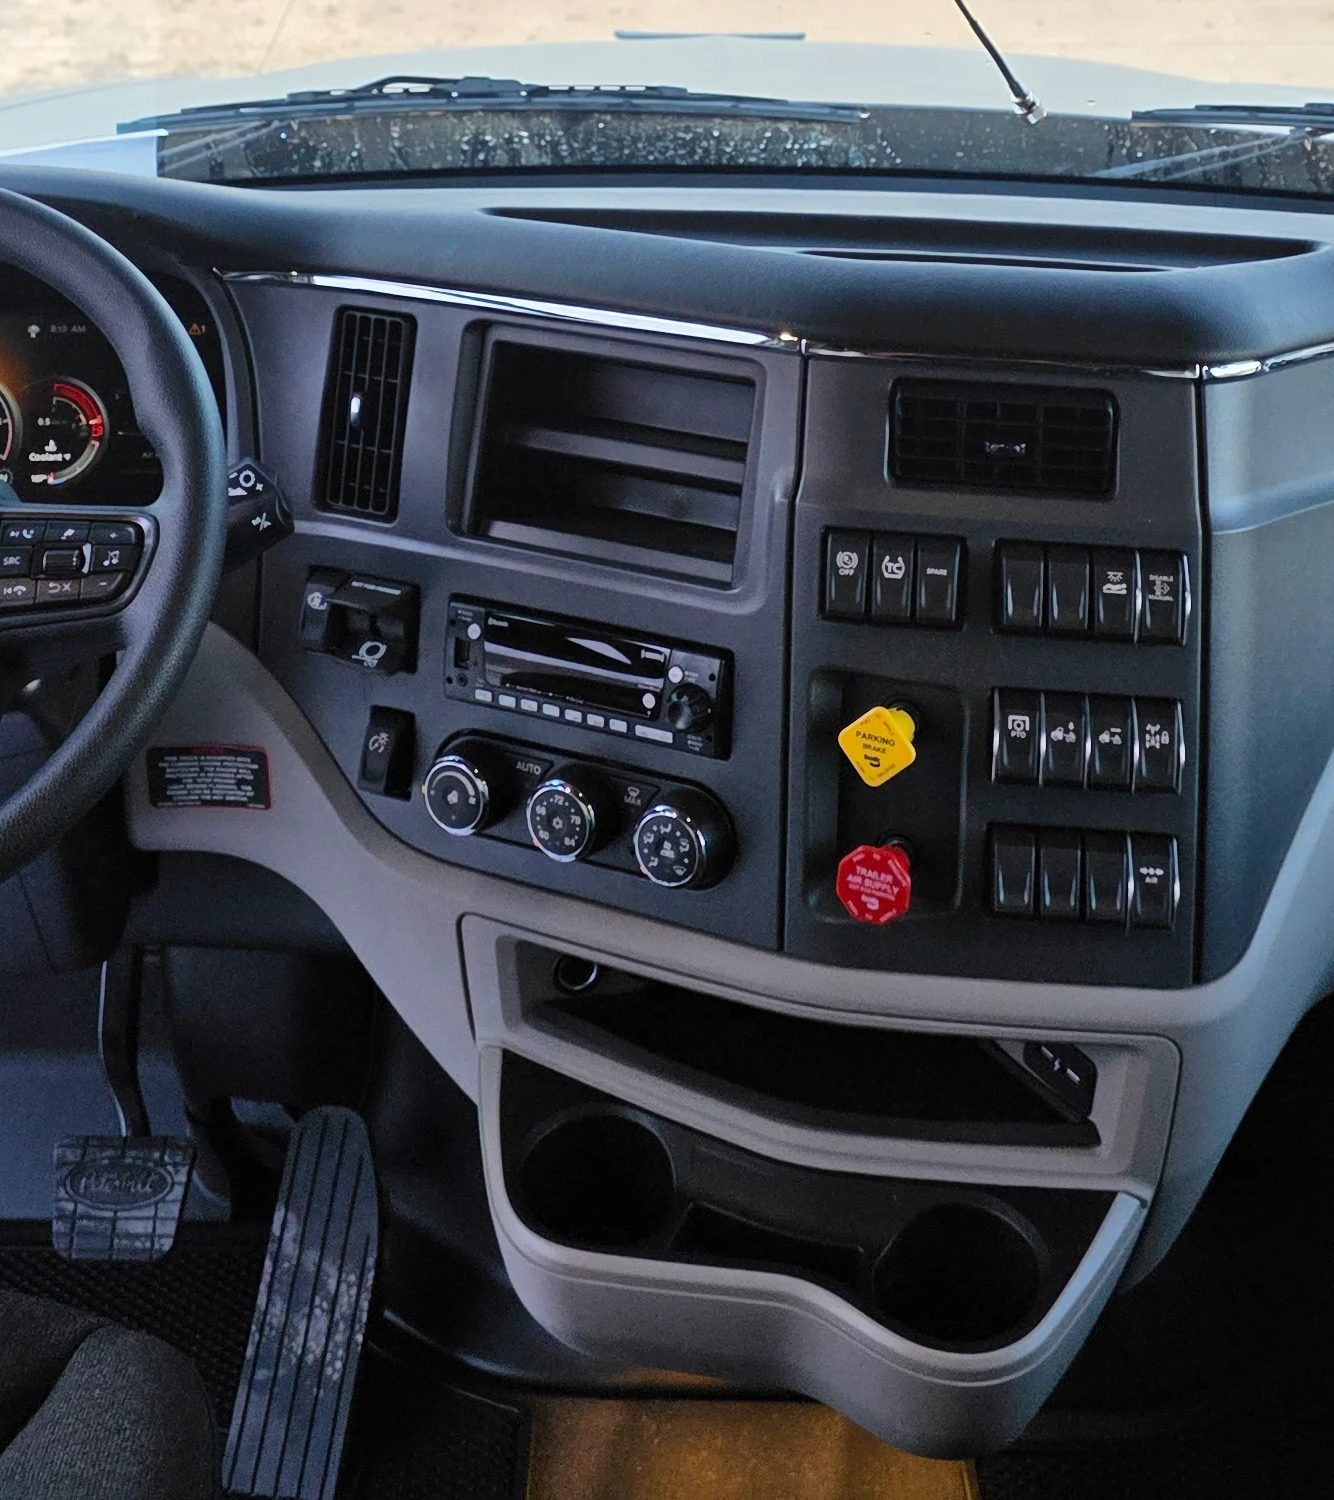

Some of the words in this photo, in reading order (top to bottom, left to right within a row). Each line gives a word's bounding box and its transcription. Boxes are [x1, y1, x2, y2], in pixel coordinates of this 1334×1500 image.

[2, 556, 21, 566] SRC
[838, 568, 855, 576] OFF
[885, 562, 901, 573] TC
[855, 730, 896, 747] PARKING
[1010, 730, 1026, 739] PTO
[862, 743, 887, 754] BRAKE
[516, 761, 542, 776] AUTO
[553, 794, 565, 806] 72
[855, 865, 894, 883] TRAILER
[846, 874, 863, 884] AIR
[863, 878, 900, 895] SUPPLY
